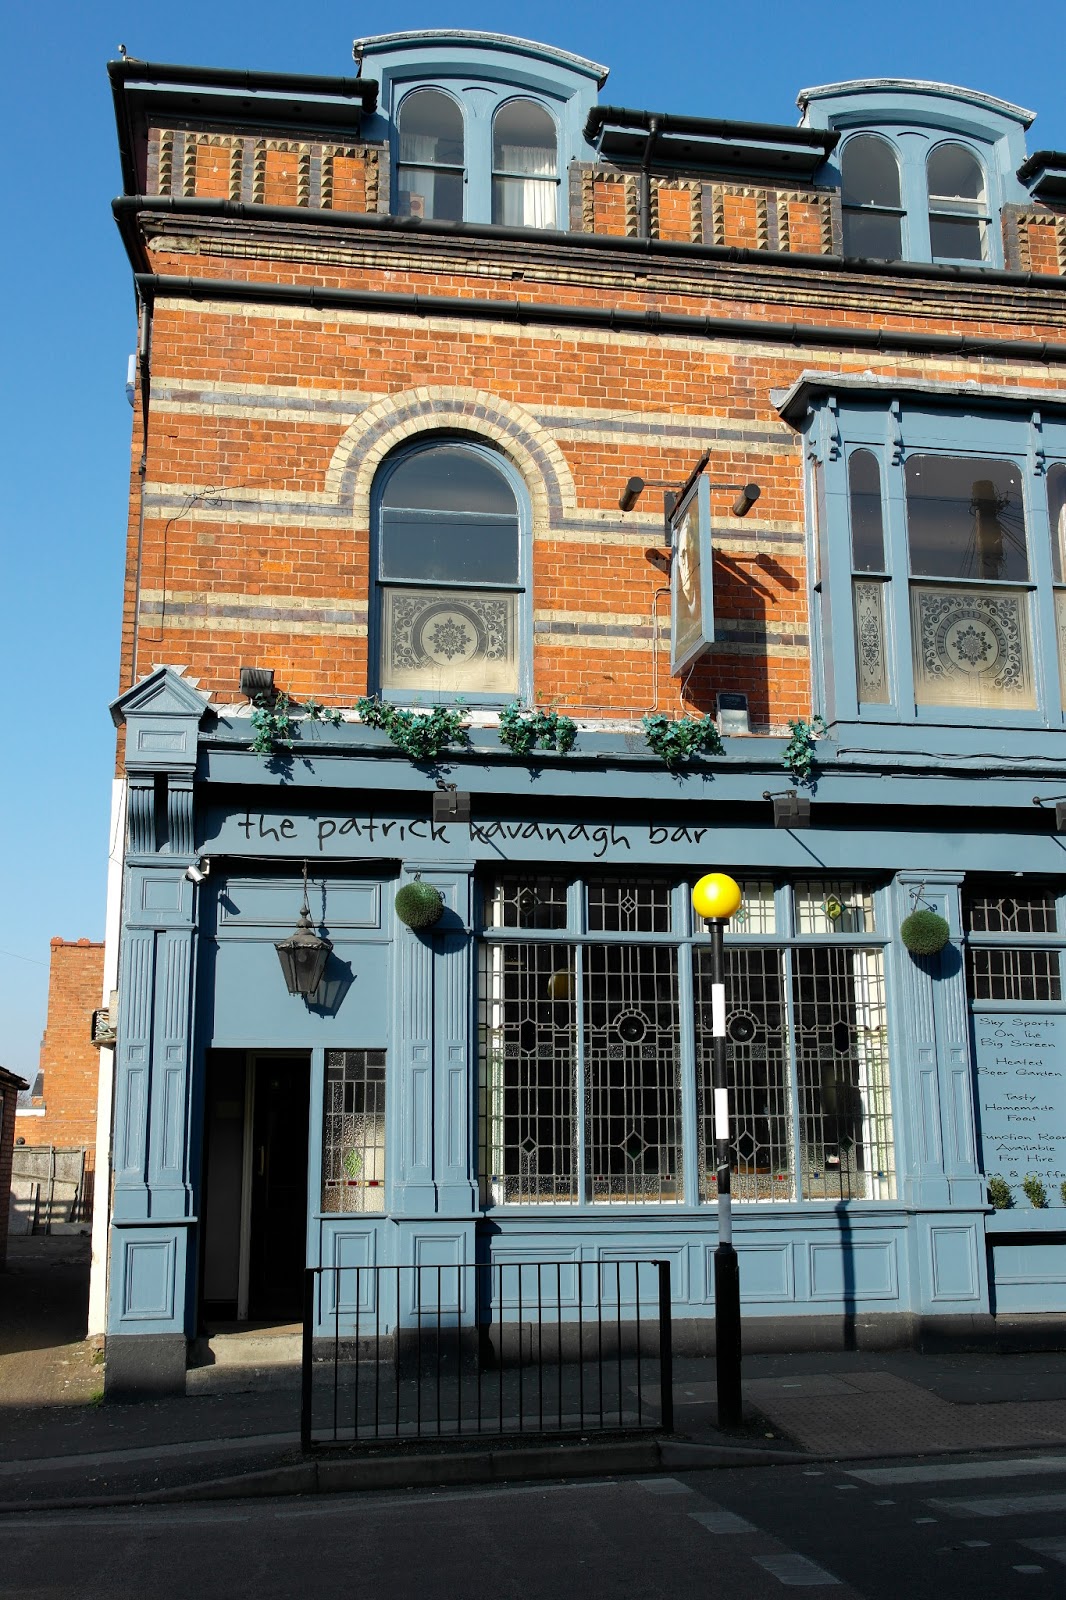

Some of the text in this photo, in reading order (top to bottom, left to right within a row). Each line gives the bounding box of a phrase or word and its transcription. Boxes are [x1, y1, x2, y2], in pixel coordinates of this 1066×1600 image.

[936, 609, 1008, 659] BILLIARD ROOM
[237, 807, 708, 857] the patrick kavanagh bar
[979, 1017, 1055, 1028] Sky Sports
[994, 1029, 1015, 1038] On
[980, 1037, 1056, 1049] Big Screen
[995, 1057, 1043, 1066] Heated
[976, 1066, 1063, 1077] Beer Garden
[1003, 1093, 1037, 1103] Tasty
[984, 1103, 1055, 1111] Homemade
[1007, 1114, 1037, 1122] Food
[976, 1132, 1032, 1141] Function
[995, 1143, 1056, 1152] Available
[1027, 1154, 1054, 1163] Hire
[1009, 1170, 1019, 1178] &
